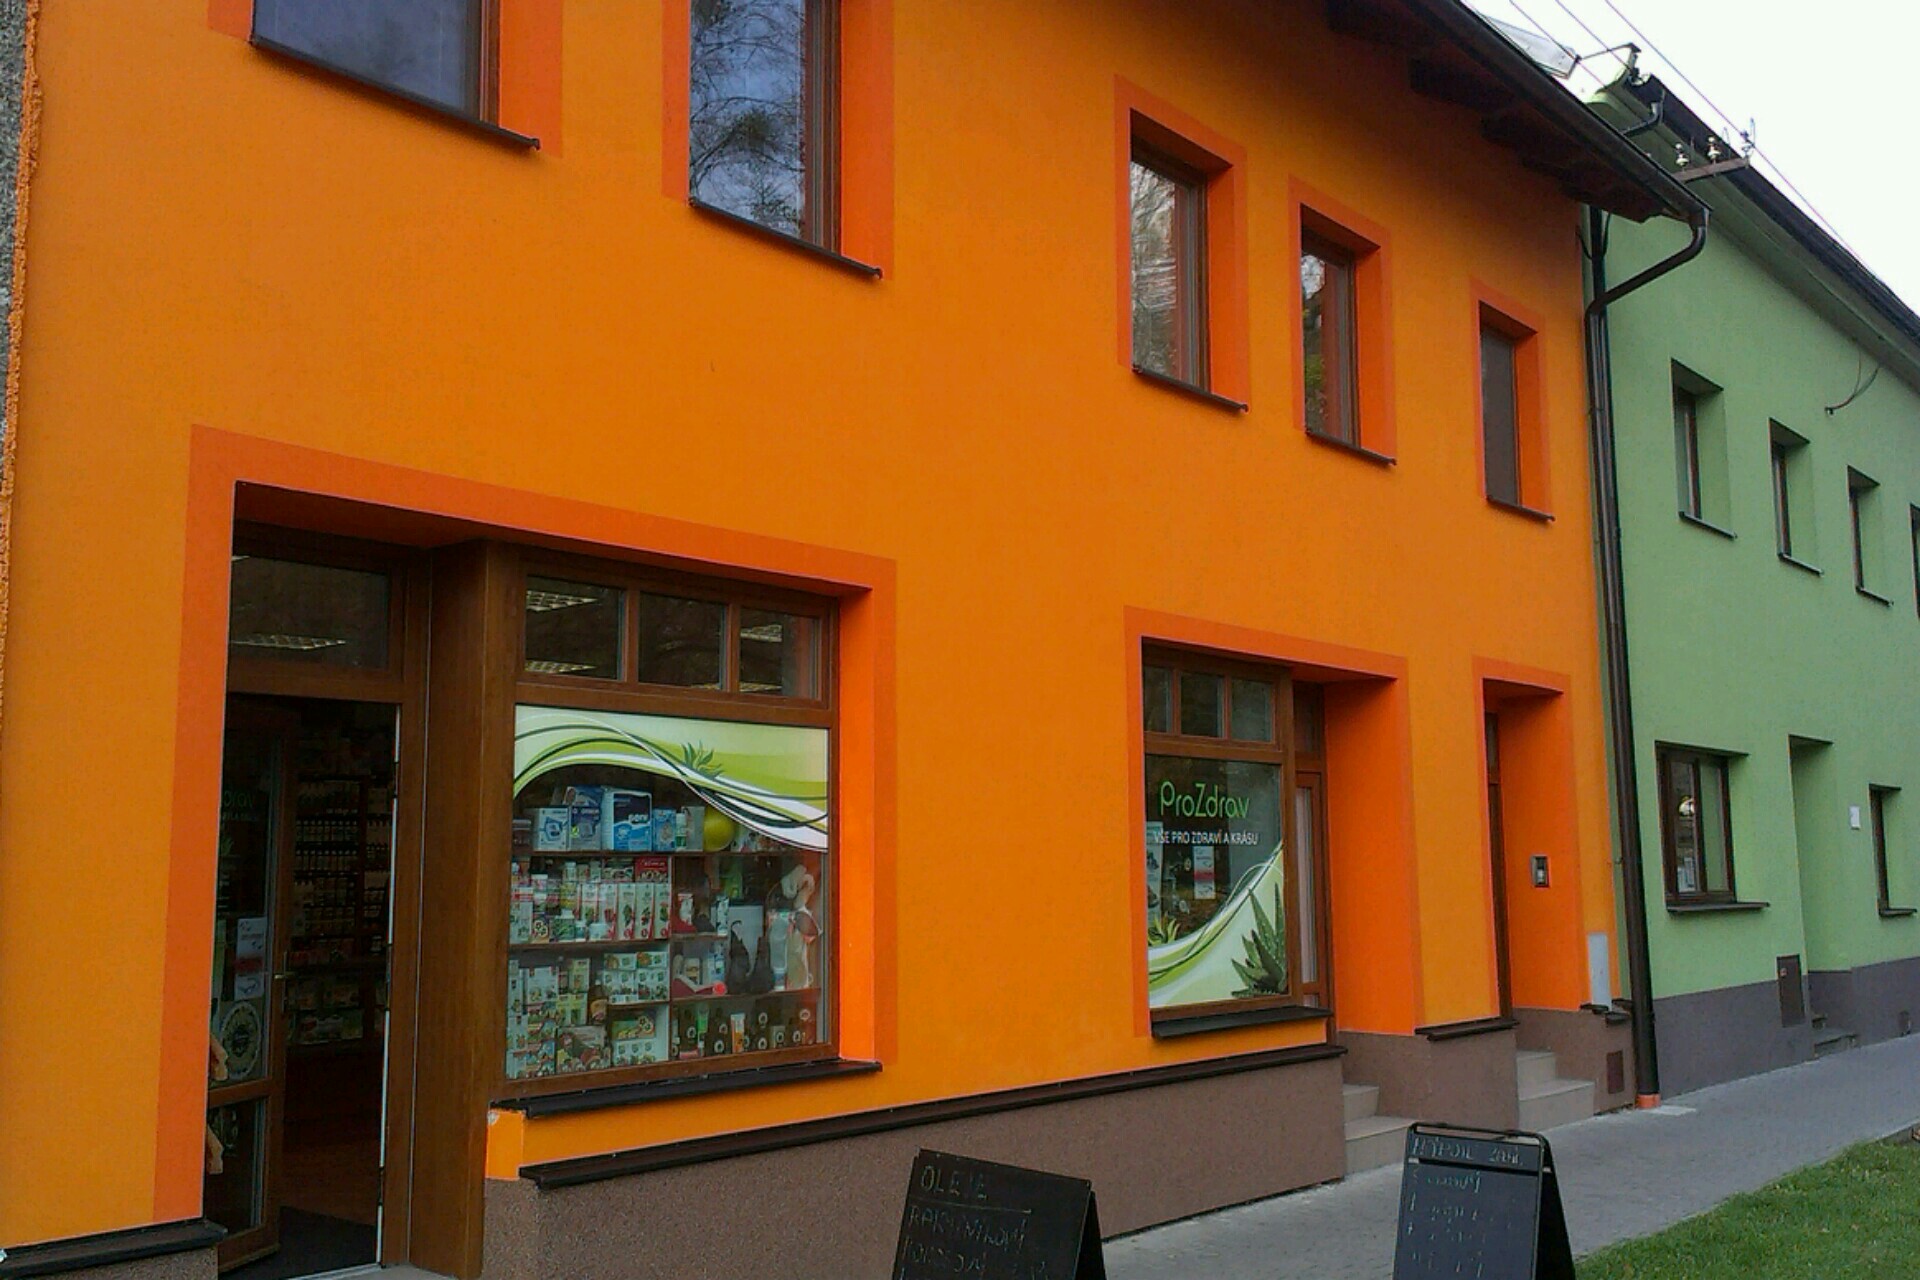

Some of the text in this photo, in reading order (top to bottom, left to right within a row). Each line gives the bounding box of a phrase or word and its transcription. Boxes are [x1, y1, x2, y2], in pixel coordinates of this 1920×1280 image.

[1160, 780, 1250, 818] ProZdrav
[1154, 828, 1258, 846] VŠE PRO ZDRAVÍ A KRÁSU
